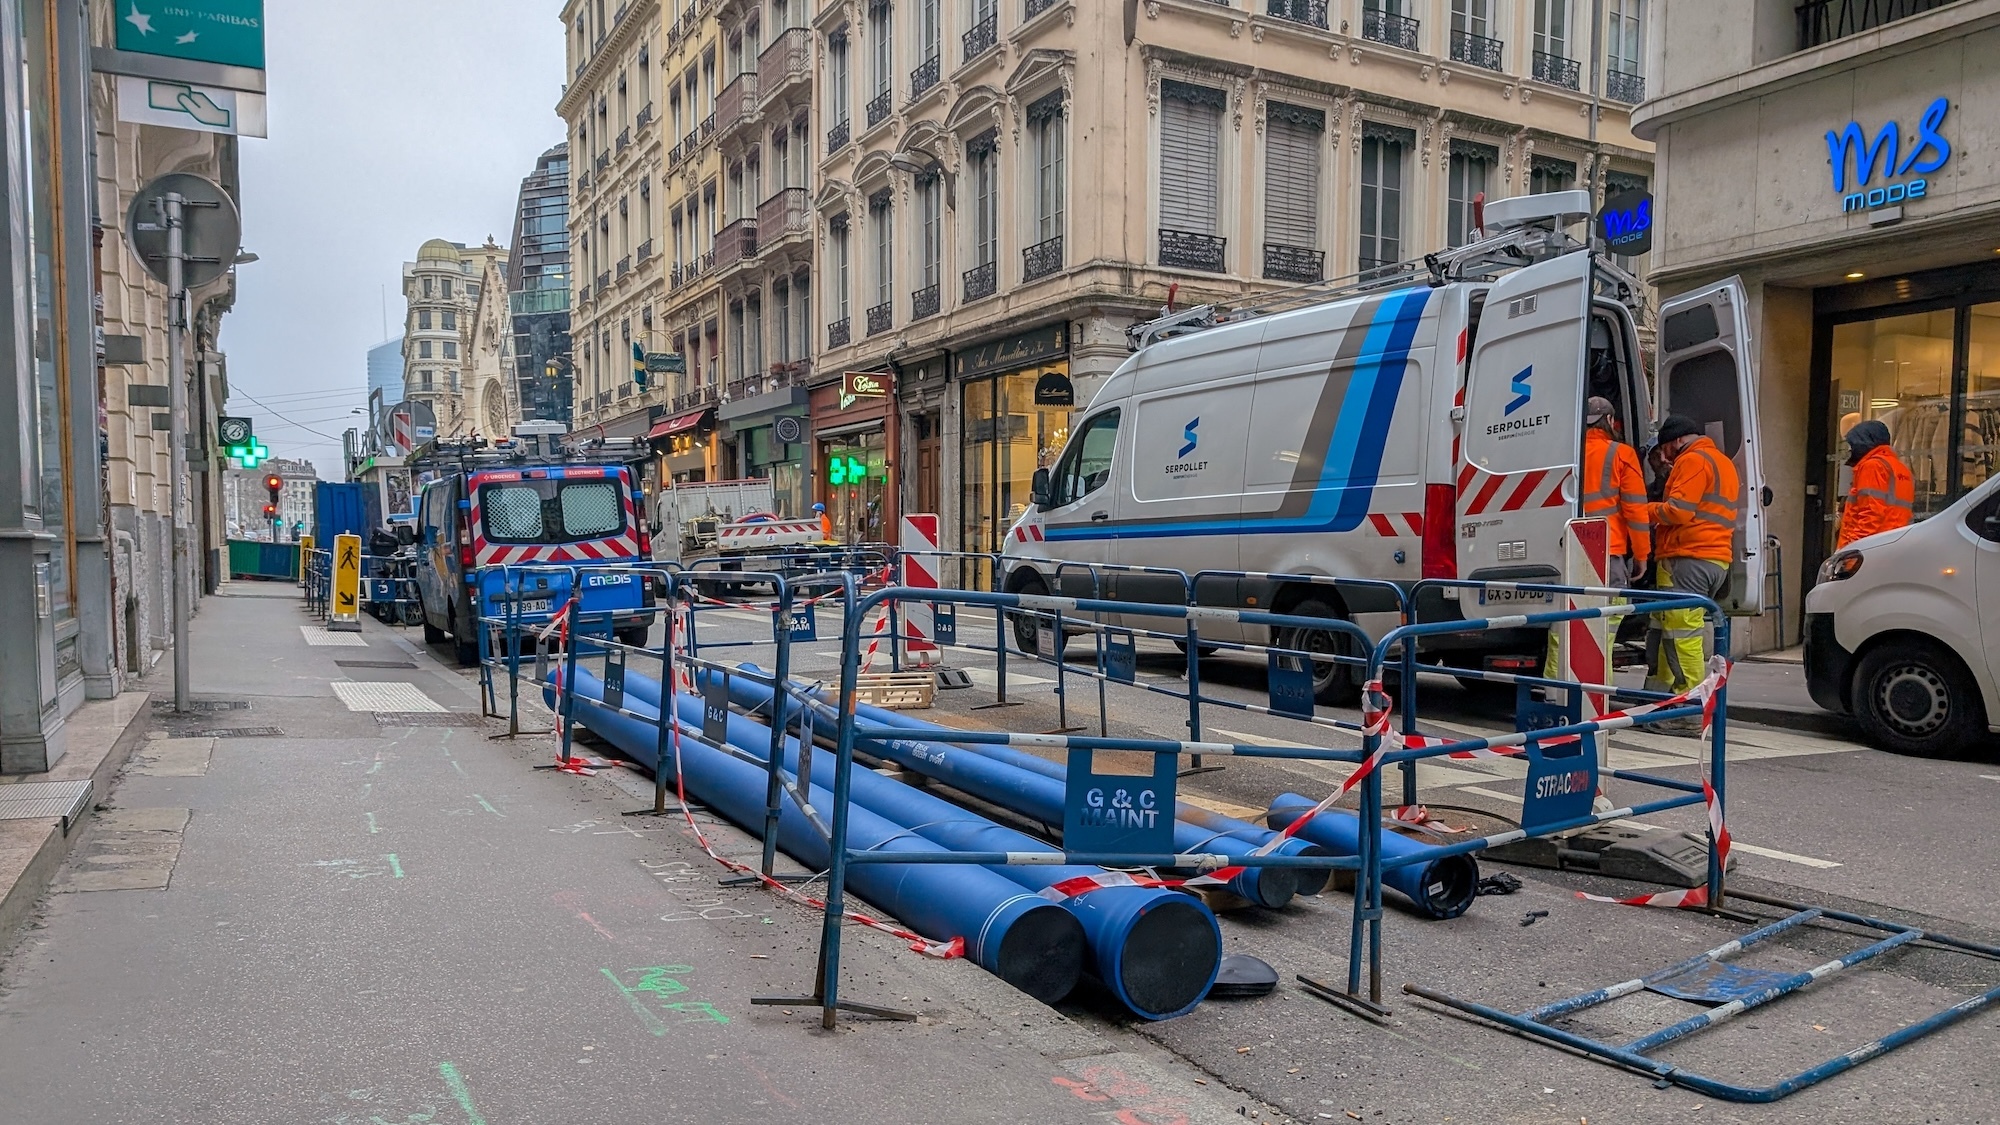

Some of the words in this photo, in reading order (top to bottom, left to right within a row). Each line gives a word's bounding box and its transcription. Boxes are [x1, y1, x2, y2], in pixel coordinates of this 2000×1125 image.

[198, 11, 259, 28] PARIBAS
[1486, 414, 1551, 436] SERPOLLET
[1165, 461, 1208, 474] SERPOLLET
[1086, 788, 1104, 808] G
[1112, 788, 1132, 808] &
[1139, 789, 1155, 809] C
[1080, 808, 1160, 829] MAINT
